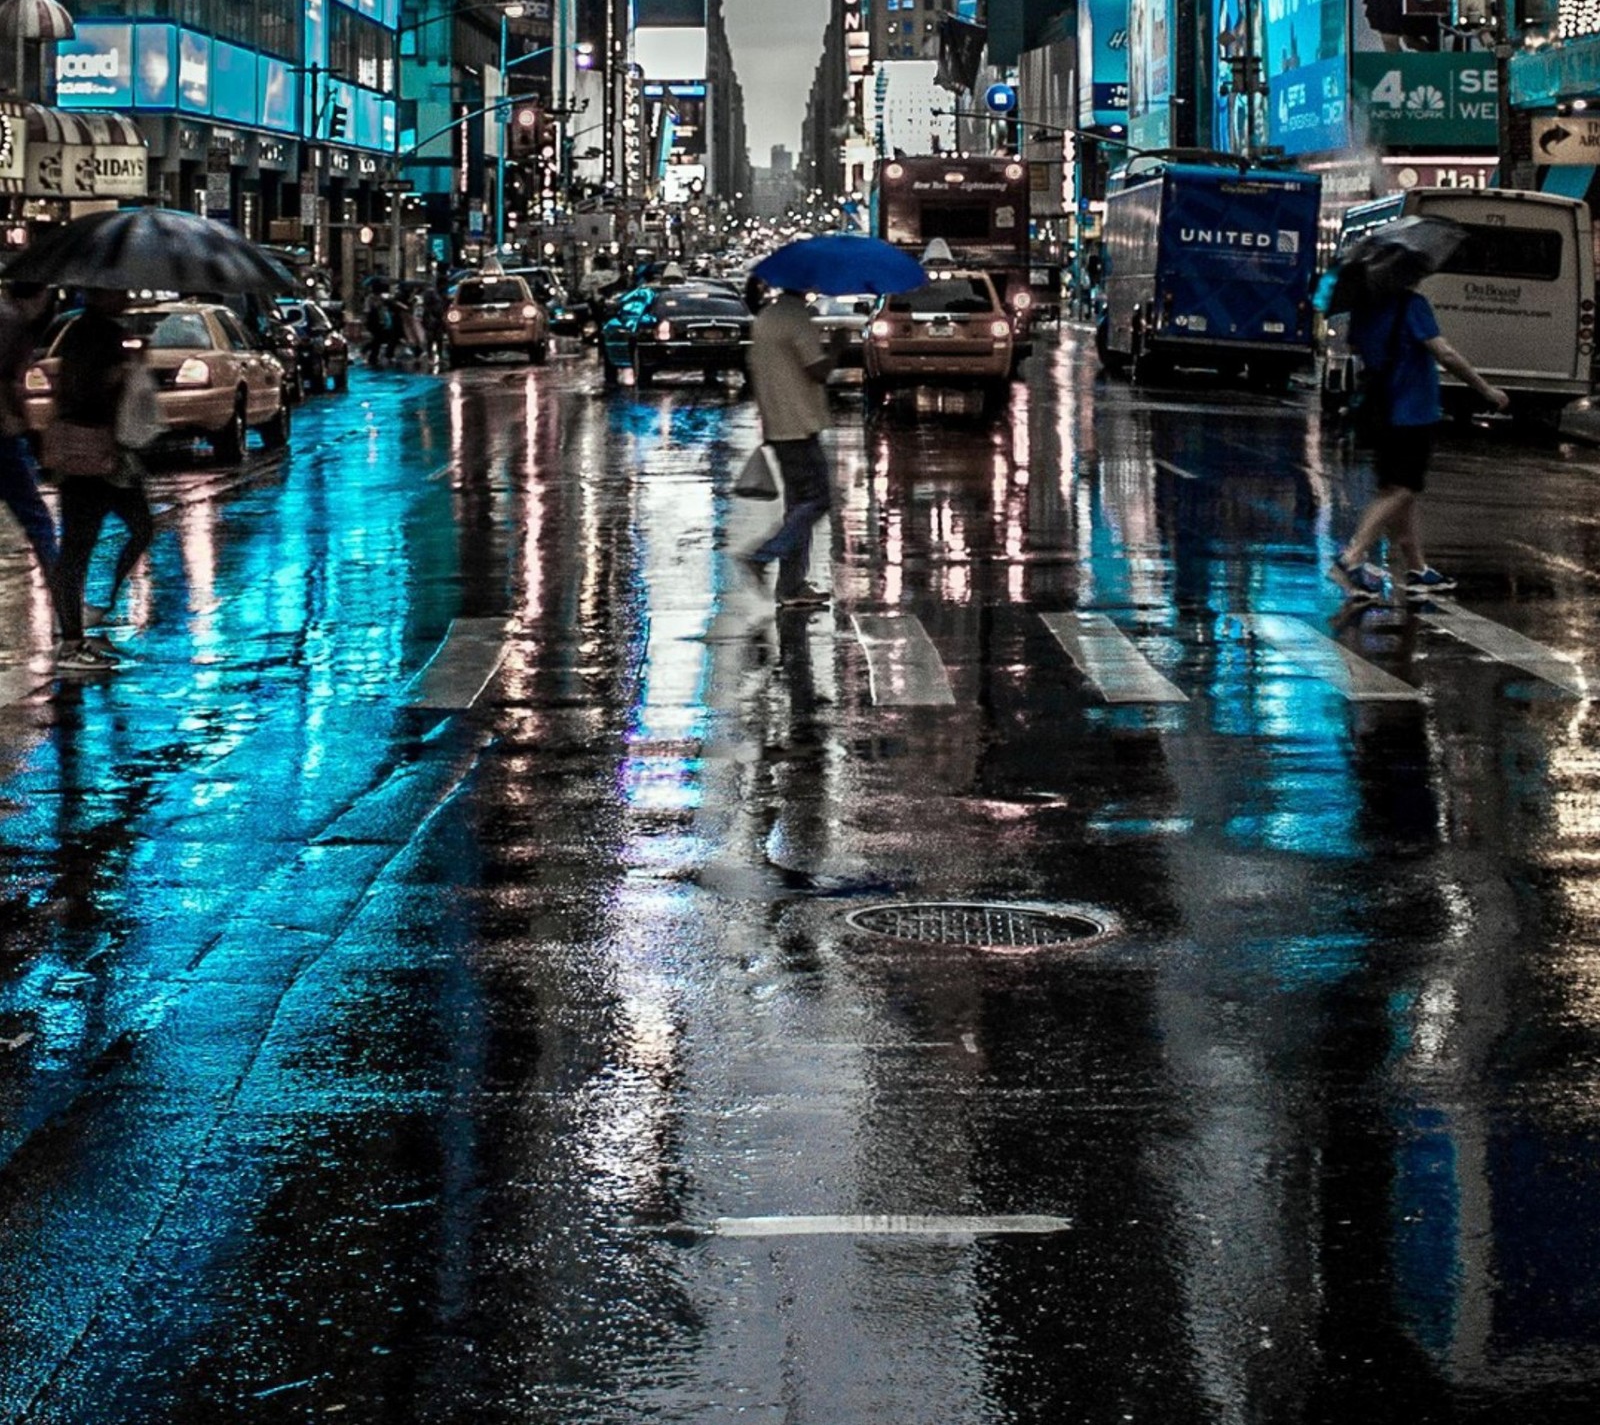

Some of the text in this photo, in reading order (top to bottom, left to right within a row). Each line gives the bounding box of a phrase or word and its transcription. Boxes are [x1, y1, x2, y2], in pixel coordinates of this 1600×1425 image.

[1371, 70, 1406, 108] 4
[1372, 110, 1445, 119] NEW YORK
[1459, 103, 1498, 119] WE
[1180, 228, 1271, 247] UNITED
